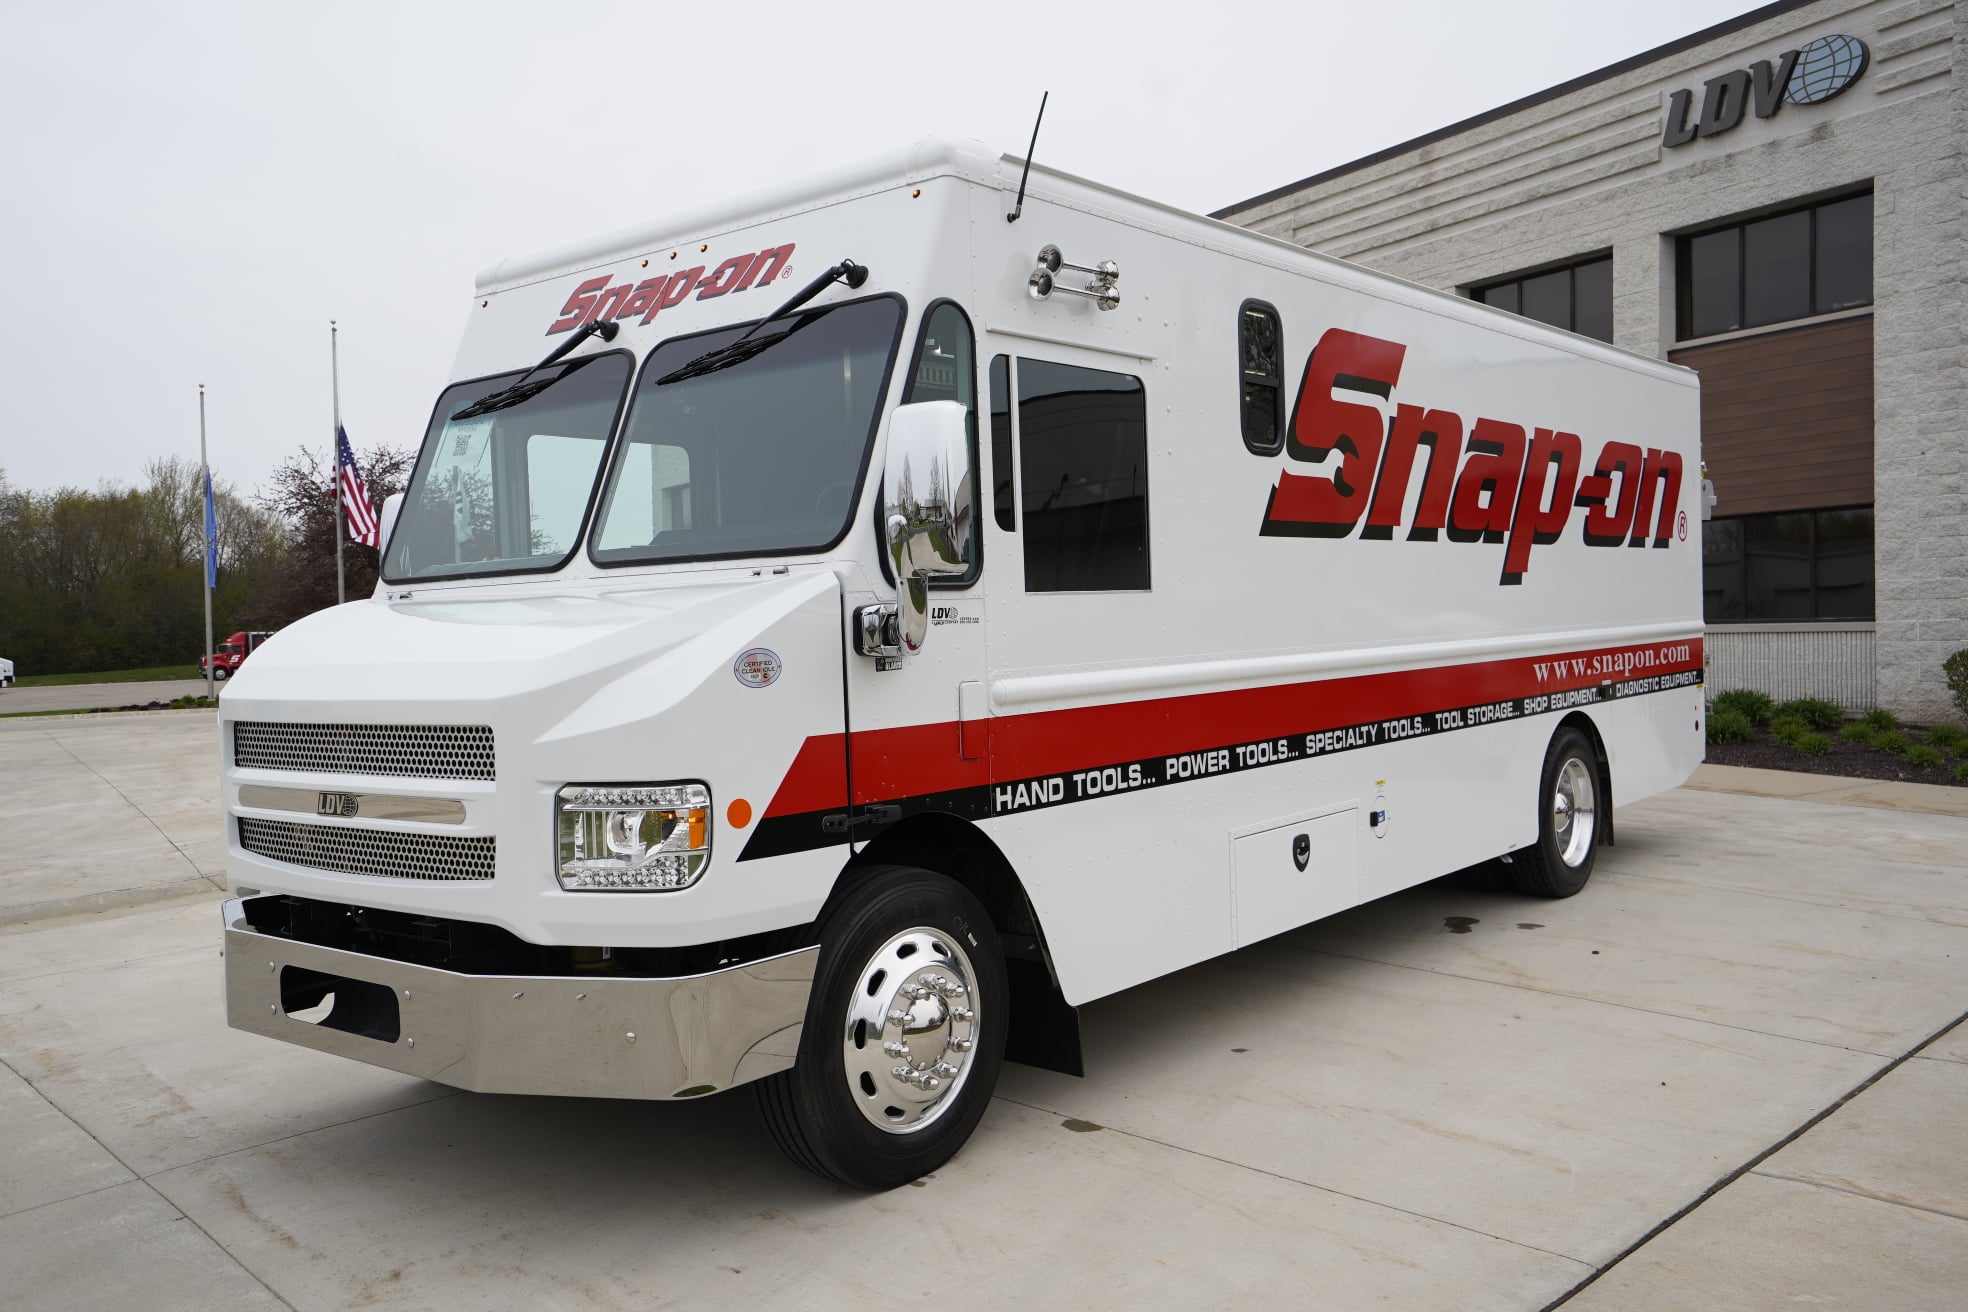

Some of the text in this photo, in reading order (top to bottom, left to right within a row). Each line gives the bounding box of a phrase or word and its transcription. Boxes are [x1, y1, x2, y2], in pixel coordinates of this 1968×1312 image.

[1663, 49, 1801, 148] LDV
[545, 242, 796, 336] Snap-on
[1258, 327, 1683, 585] Snap-on
[931, 607, 950, 619] LDV
[1533, 643, 1690, 683] www.snapon.com
[995, 777, 1064, 811] HAND
[1166, 749, 1230, 780] POWER
[1306, 724, 1378, 754] SPECIALTY
[1435, 710, 1464, 730] TOOL
[1523, 696, 1548, 714] SHOP
[1615, 677, 1660, 698] DIAGNOSTIC
[318, 793, 345, 814] LDV
